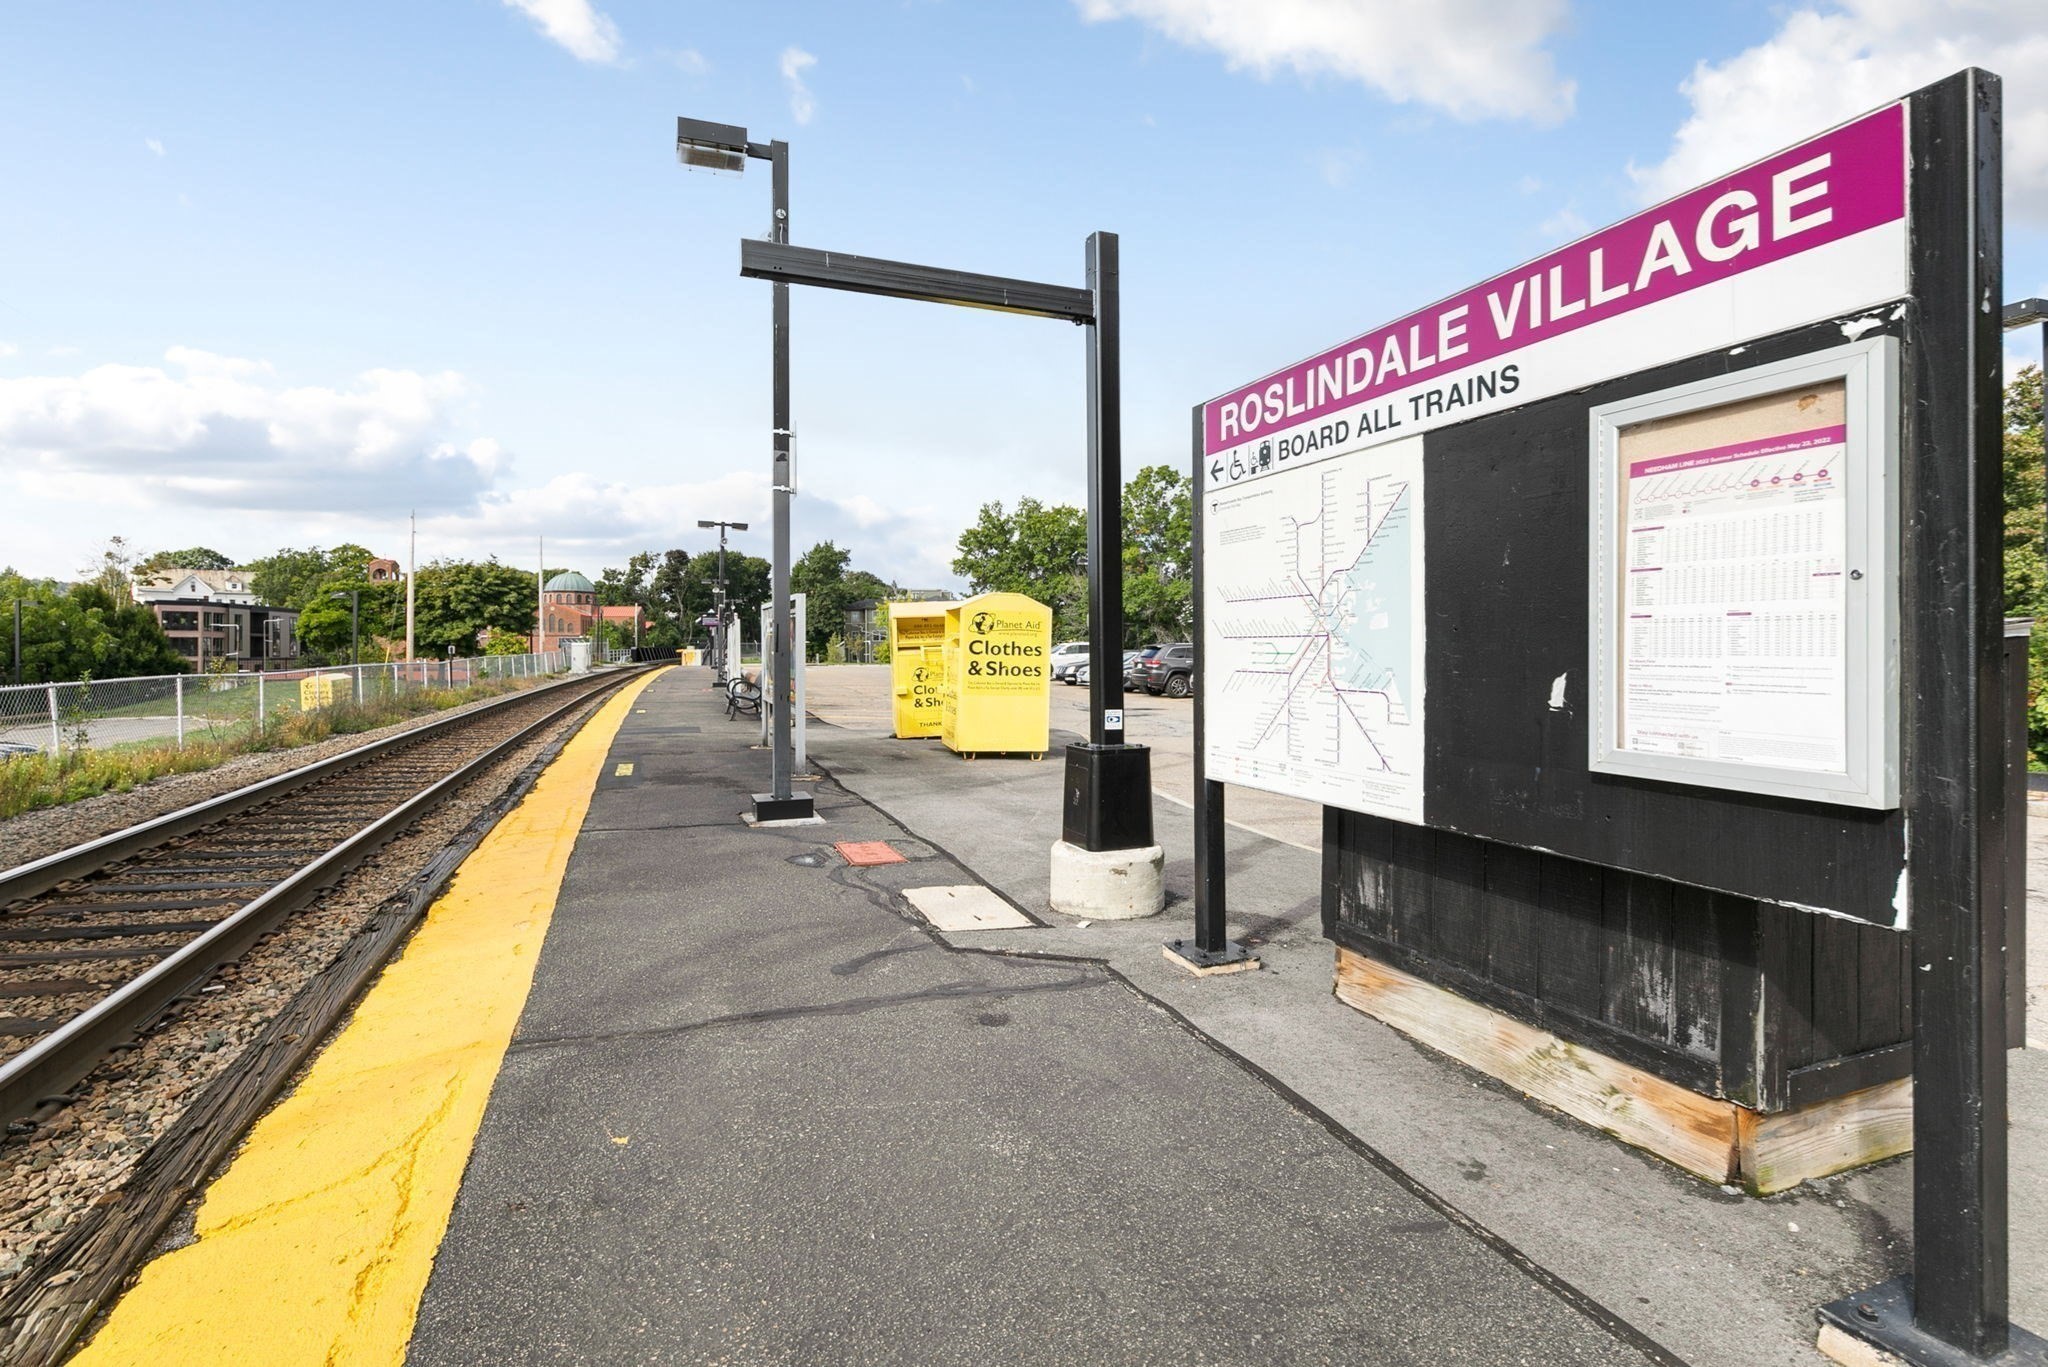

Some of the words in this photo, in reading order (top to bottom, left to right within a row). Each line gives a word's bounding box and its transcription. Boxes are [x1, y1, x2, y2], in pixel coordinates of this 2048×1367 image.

[1220, 304, 1469, 441] ROSLINDALE
[1486, 153, 1833, 341] VILLAGE
[1279, 420, 1349, 461] BOARD
[1357, 412, 1402, 438] ALL
[1409, 364, 1520, 421] TRAINS
[1644, 462, 1678, 474] NEEDHAM
[1679, 460, 1695, 468] LINE
[996, 619, 1023, 629] Planet
[1025, 620, 1041, 630] Aid
[968, 640, 1042, 657] Clothes
[968, 660, 982, 676] &
[986, 661, 1042, 677] Shoes
[914, 698, 923, 708] &
